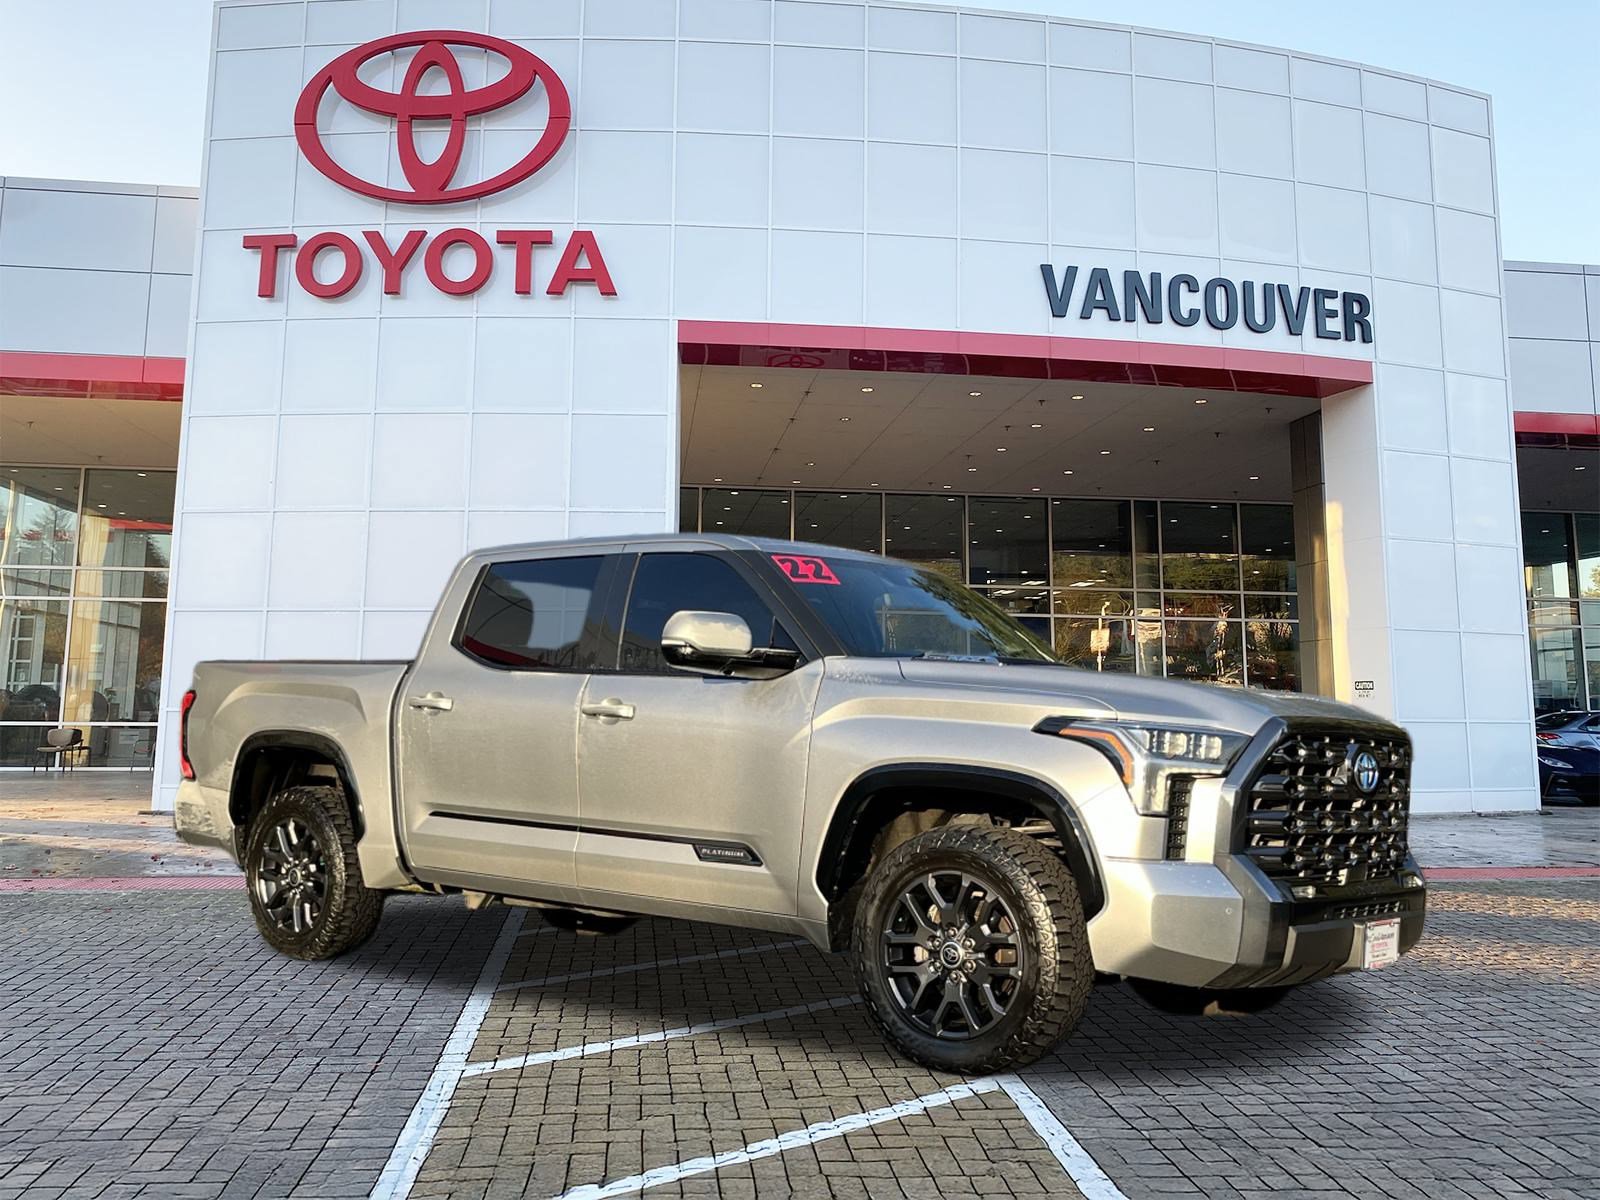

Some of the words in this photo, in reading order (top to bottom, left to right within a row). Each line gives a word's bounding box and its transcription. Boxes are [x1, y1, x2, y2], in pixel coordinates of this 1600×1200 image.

[243, 228, 617, 299] TOYOTA
[1040, 263, 1373, 344] VANCOUVER
[777, 557, 833, 581] 22
[701, 848, 744, 857] PLATINUM
